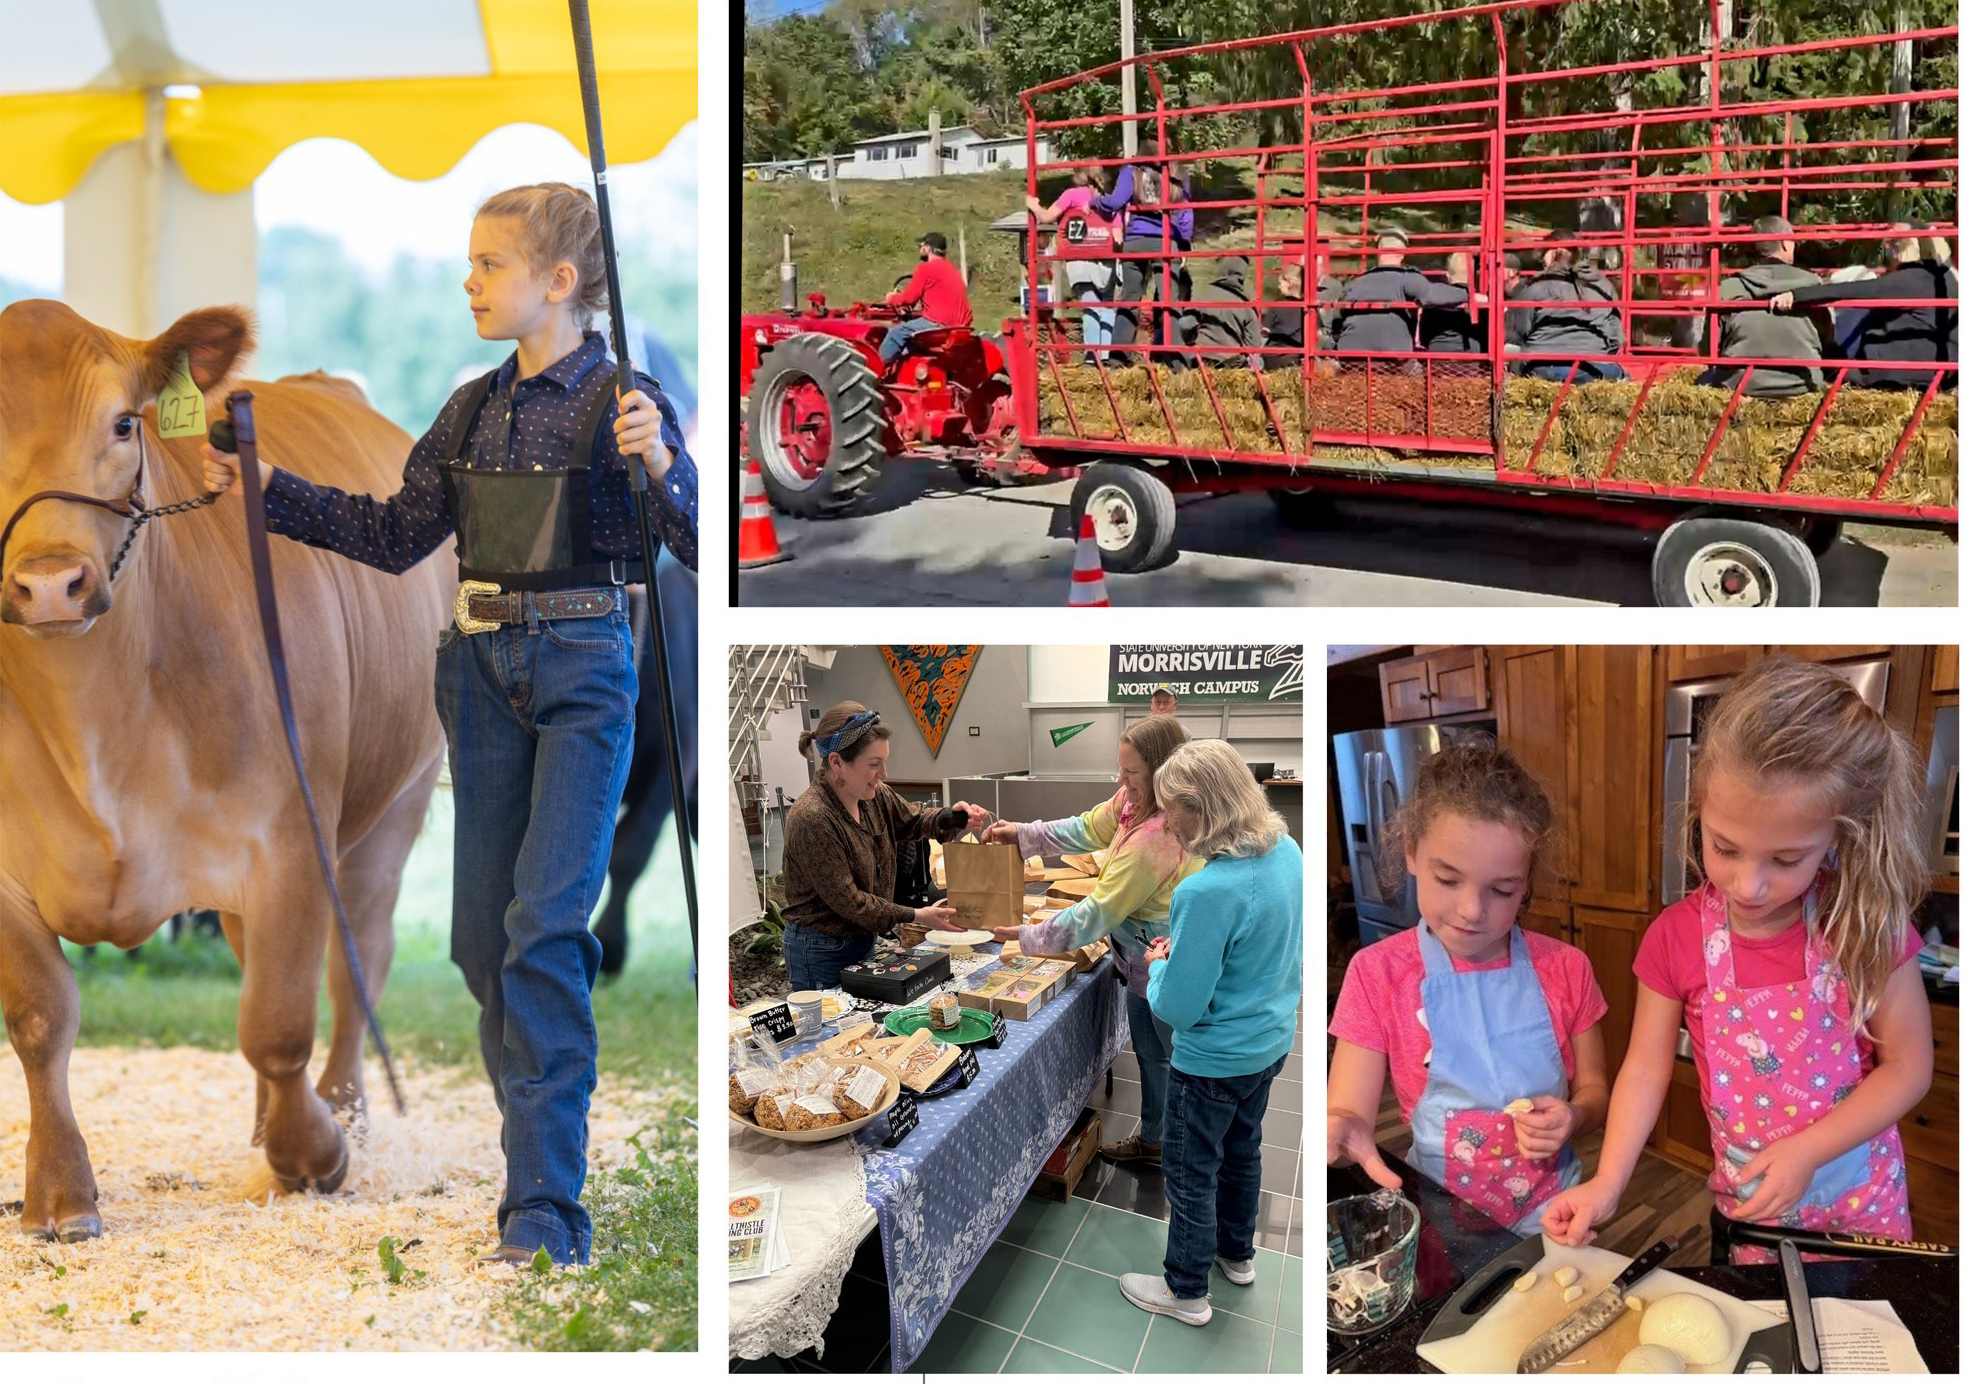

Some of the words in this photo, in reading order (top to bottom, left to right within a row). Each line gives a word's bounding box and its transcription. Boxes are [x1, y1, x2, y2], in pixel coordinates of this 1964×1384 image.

[160, 395, 200, 431] 627
[1118, 650, 1262, 673] MORRISVILLE
[1194, 681, 1259, 694] CAMPUS
[1745, 989, 1773, 1009] PEPPA
[1785, 1027, 1810, 1053] PEPPA
[1716, 1047, 1741, 1068] PEPPA
[1781, 1082, 1810, 1100] PEPPA
[1766, 1124, 1795, 1141] PEPPA
[735, 1219, 765, 1230] THISTLE
[744, 1226, 763, 1236] CLUB
